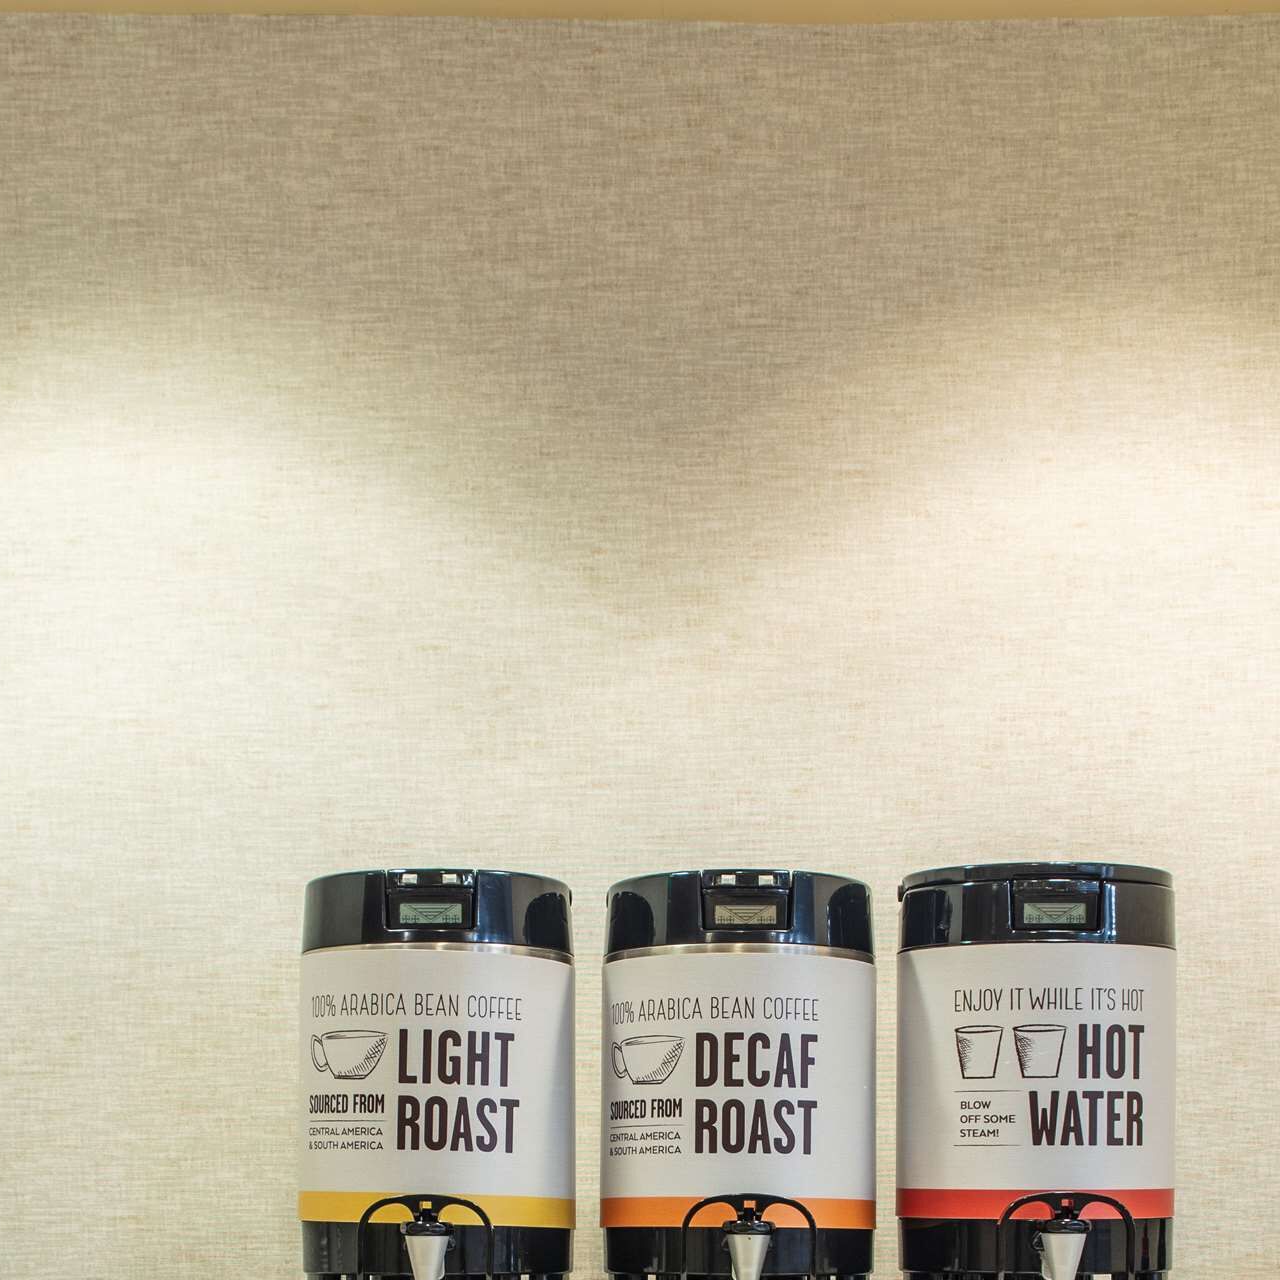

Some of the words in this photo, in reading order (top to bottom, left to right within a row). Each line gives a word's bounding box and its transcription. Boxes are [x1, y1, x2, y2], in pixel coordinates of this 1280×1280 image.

[311, 994, 336, 1018] 100%
[340, 993, 407, 1017] ARABICA
[414, 993, 459, 1017] BEAN
[467, 995, 523, 1021] COFFEE
[611, 1000, 635, 1025] 100%
[638, 997, 703, 1022] ARABICA
[710, 996, 755, 1020] BEAN
[763, 996, 820, 1022] COFFEE
[953, 988, 1003, 1013] ENJOY
[1010, 987, 1024, 1011] IT
[1029, 987, 1084, 1011] WHILE
[1091, 987, 1116, 1011] IT'S
[1121, 988, 1145, 1012] HOT
[398, 1028, 515, 1087] LIGHT
[695, 1032, 818, 1089] DECAF
[1078, 1023, 1145, 1080] HOT
[309, 1094, 349, 1115] SOURCED
[352, 1093, 385, 1114] FROM
[610, 1099, 647, 1121] SOURCED
[650, 1097, 683, 1118] FROM
[960, 1100, 992, 1110] BLOW
[396, 1095, 520, 1154] ROAST
[694, 1098, 818, 1155] ROAST
[960, 1114, 981, 1124] OFF
[983, 1114, 1016, 1124] SOME
[1028, 1090, 1144, 1146] WATER
[309, 1127, 340, 1136] CENTRAL
[341, 1127, 384, 1136] AMERICA
[609, 1132, 639, 1142] CENTRAL
[639, 1131, 681, 1141] AMERICA
[959, 1128, 1000, 1138] STEAM!
[314, 1141, 339, 1150] SOUTH
[340, 1141, 384, 1150] AMERICA
[614, 1146, 638, 1156] SOUTH
[638, 1145, 682, 1155] AMERICA
